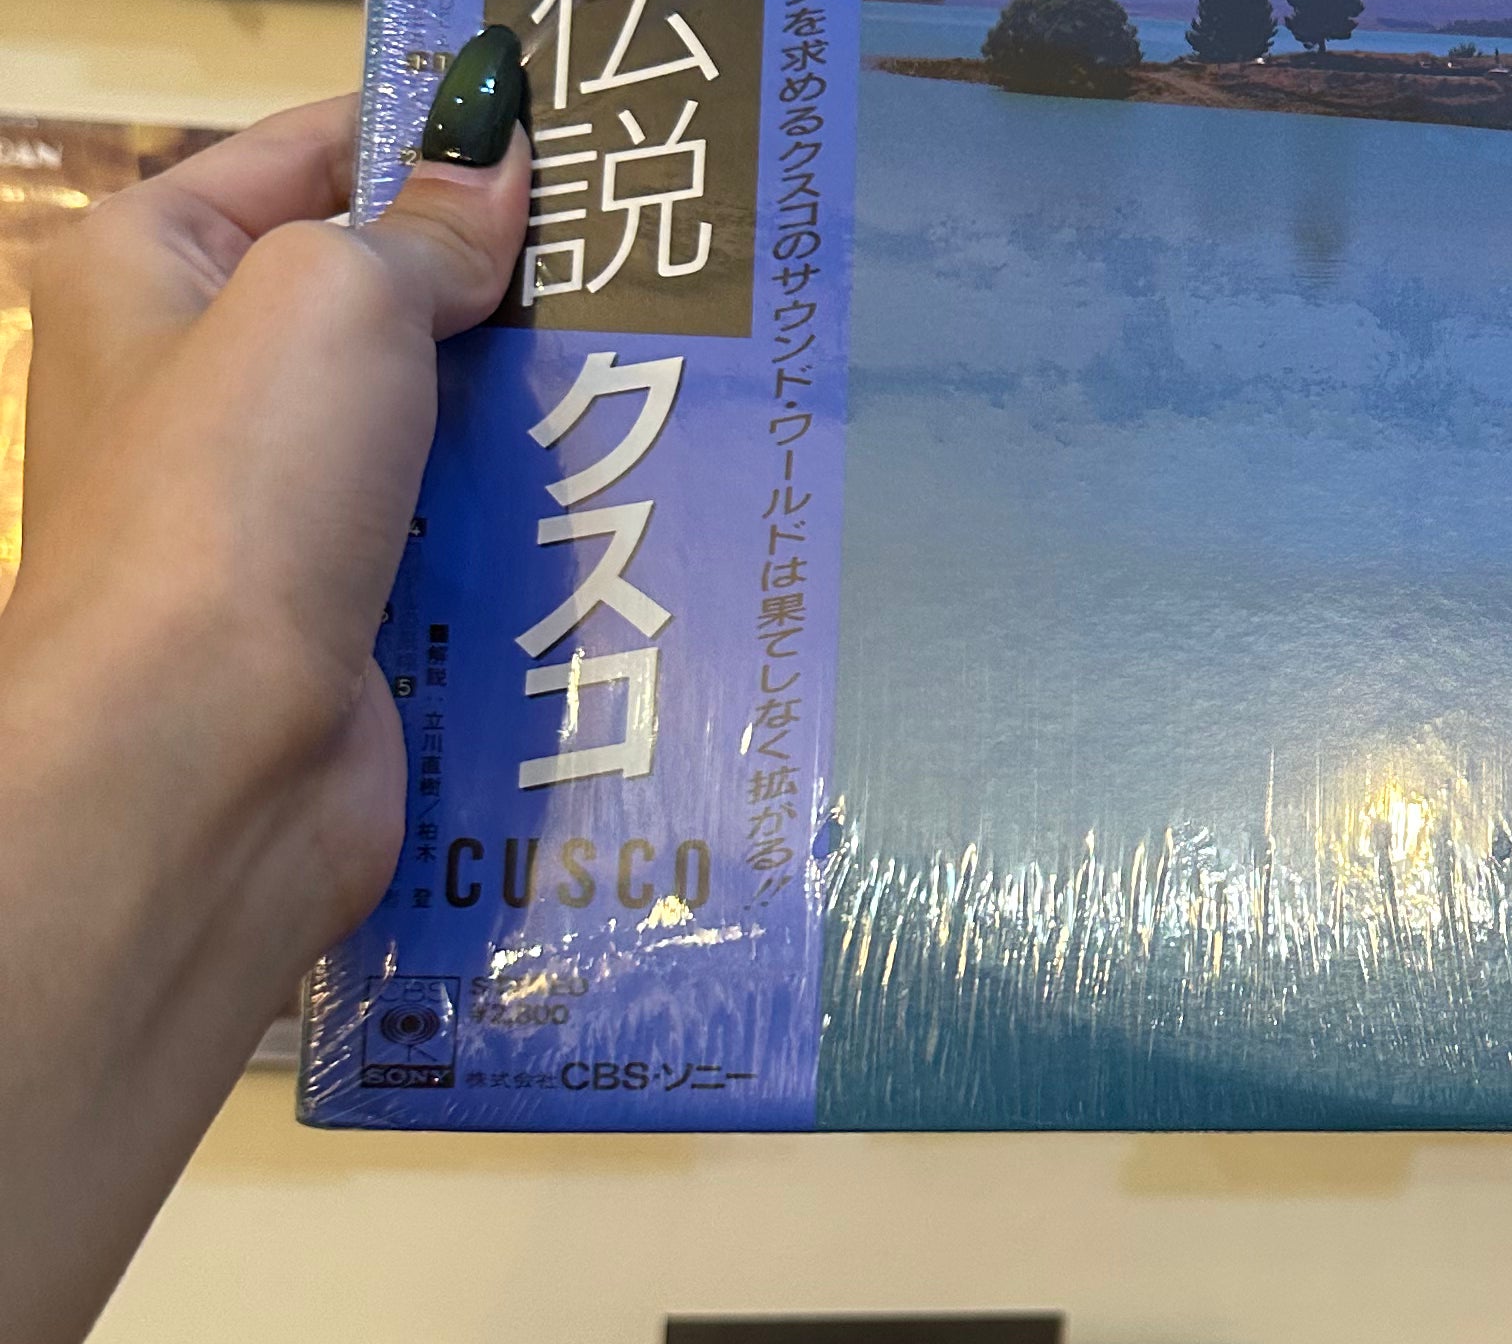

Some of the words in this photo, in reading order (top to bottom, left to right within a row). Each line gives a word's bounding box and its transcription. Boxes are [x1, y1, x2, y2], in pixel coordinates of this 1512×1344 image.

[514, 351, 684, 790] クスコ
[445, 837, 712, 910] CUSCO
[363, 1067, 449, 1087] SONY
